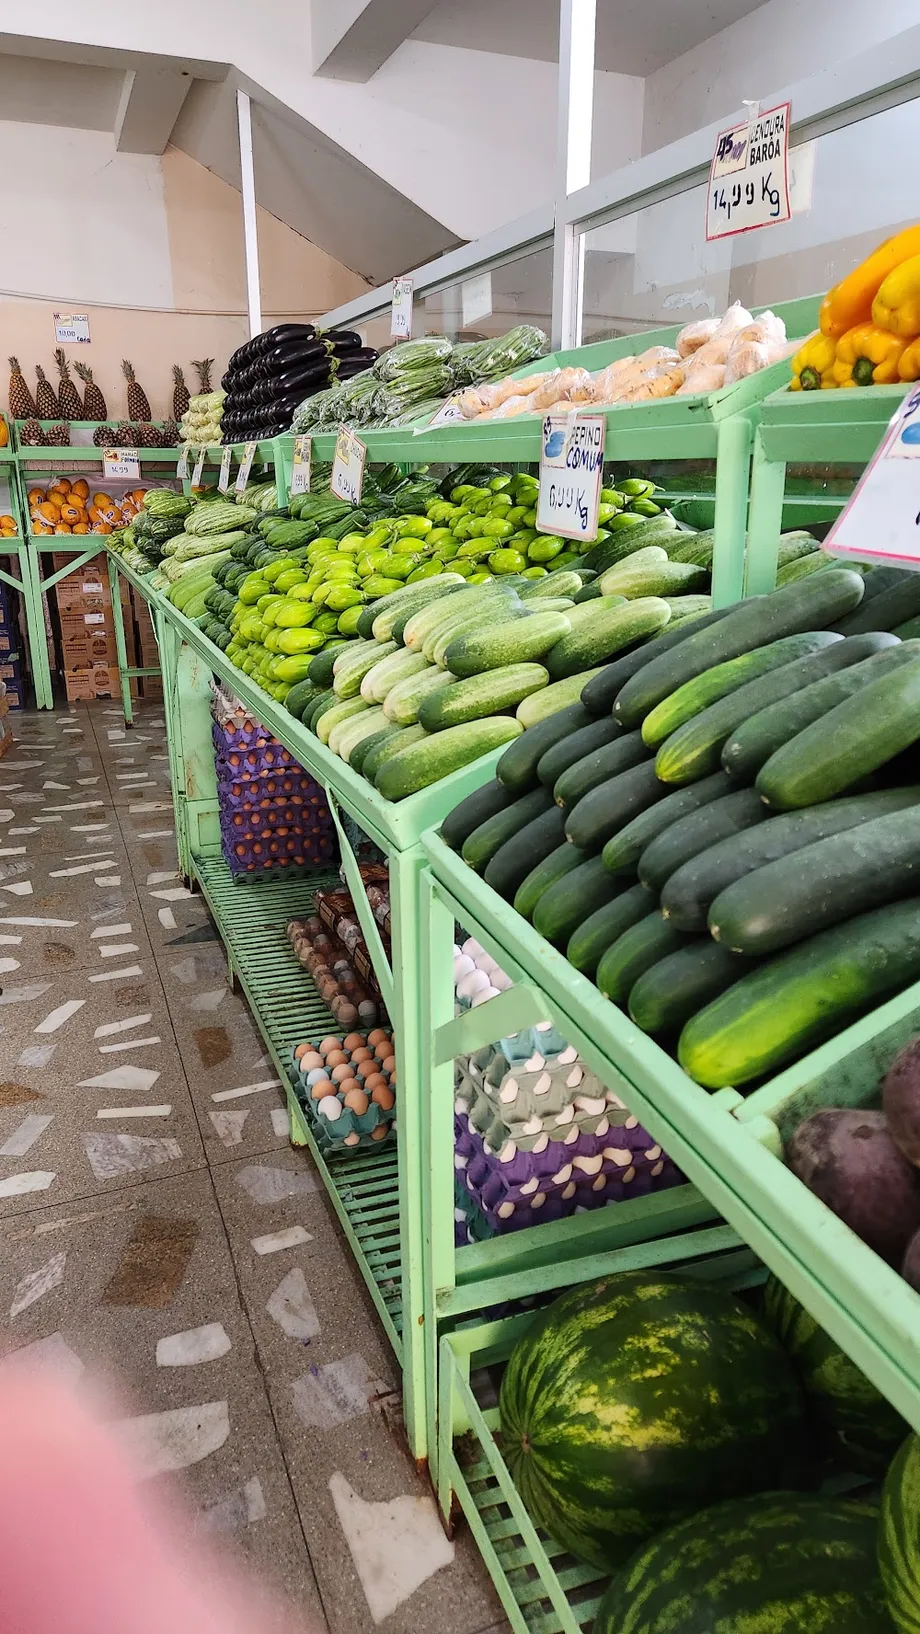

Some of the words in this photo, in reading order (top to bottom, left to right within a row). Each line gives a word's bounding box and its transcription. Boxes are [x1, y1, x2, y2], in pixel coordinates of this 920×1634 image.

[749, 137, 781, 166] BARÔA
[713, 184, 755, 219] 14,99
[761, 172, 780, 217] Kg
[569, 426, 601, 446] PEPINO
[566, 447, 604, 473] COMUM
